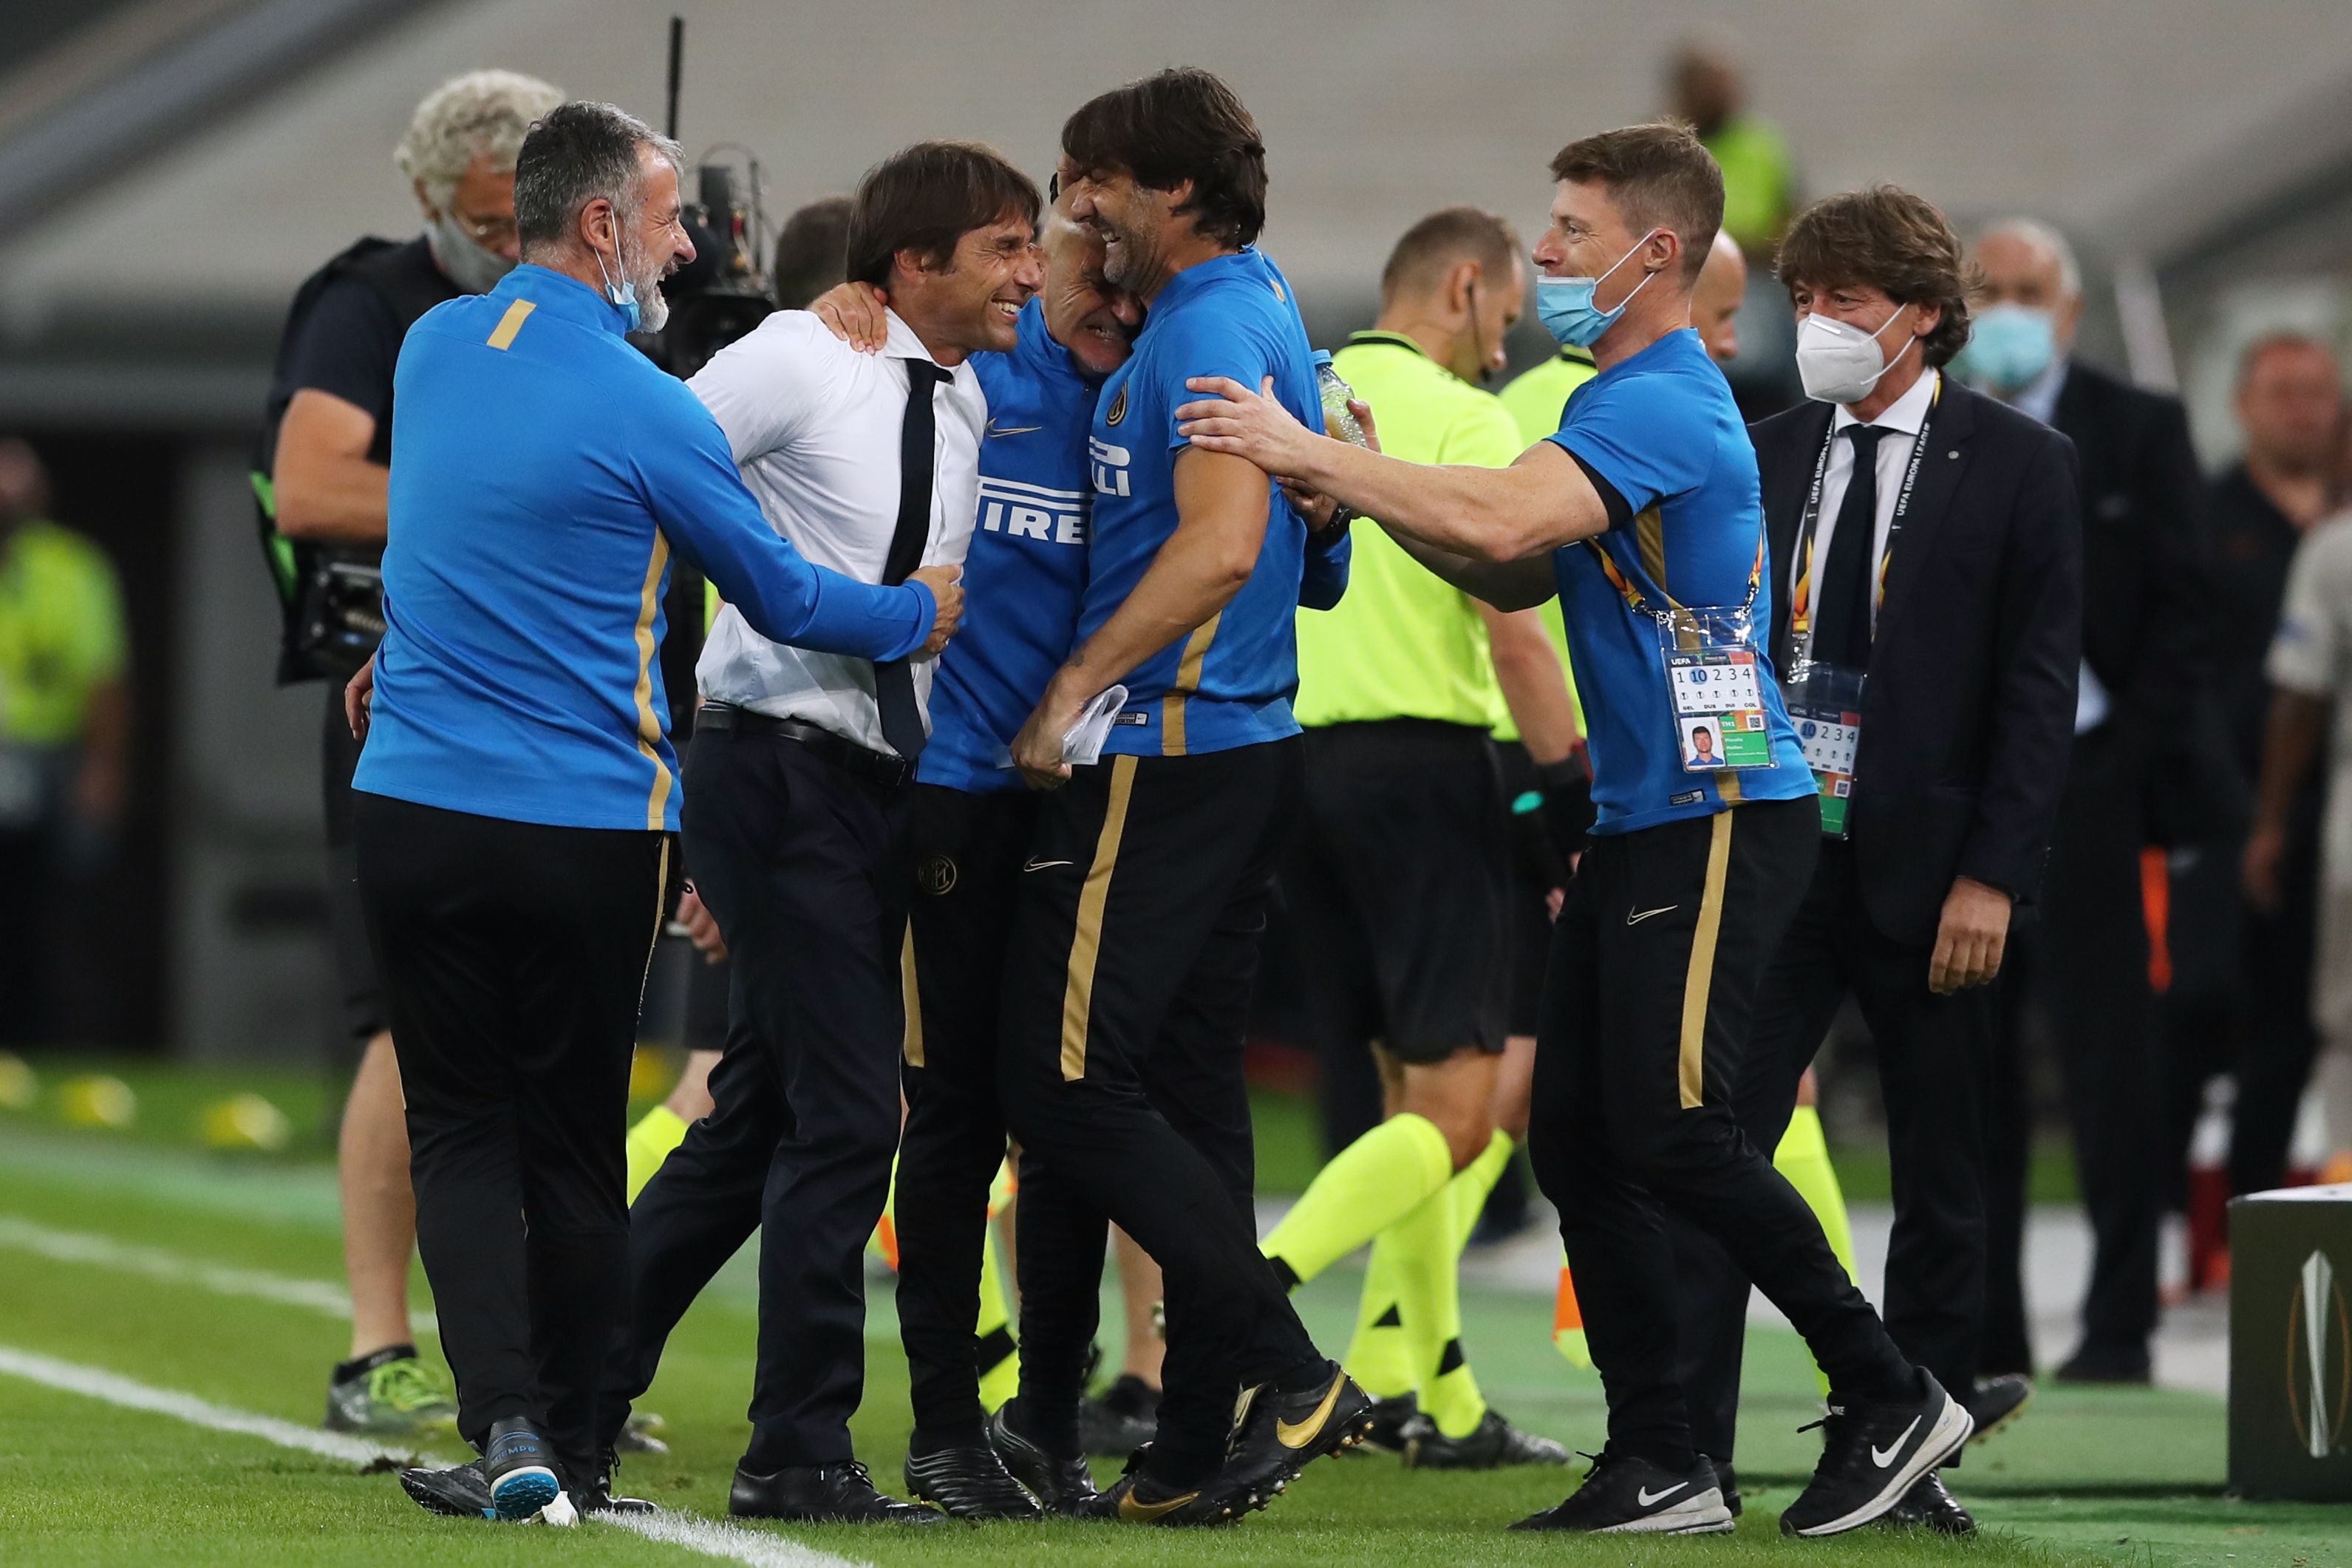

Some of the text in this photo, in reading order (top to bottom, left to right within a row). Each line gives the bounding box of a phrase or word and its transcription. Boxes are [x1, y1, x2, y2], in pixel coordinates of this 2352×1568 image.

[1815, 445, 1830, 478] EUROPA
[1810, 477, 1821, 504] UEFA
[1896, 493, 1910, 517] UEFA
[1903, 457, 1921, 491] EUROPA
[1677, 668, 1751, 684] 1 10 2 3 4
[1801, 723, 1816, 737] 10
[1820, 726, 1829, 739] 2
[1833, 728, 1843, 742] 3
[1847, 731, 1855, 744] 4
